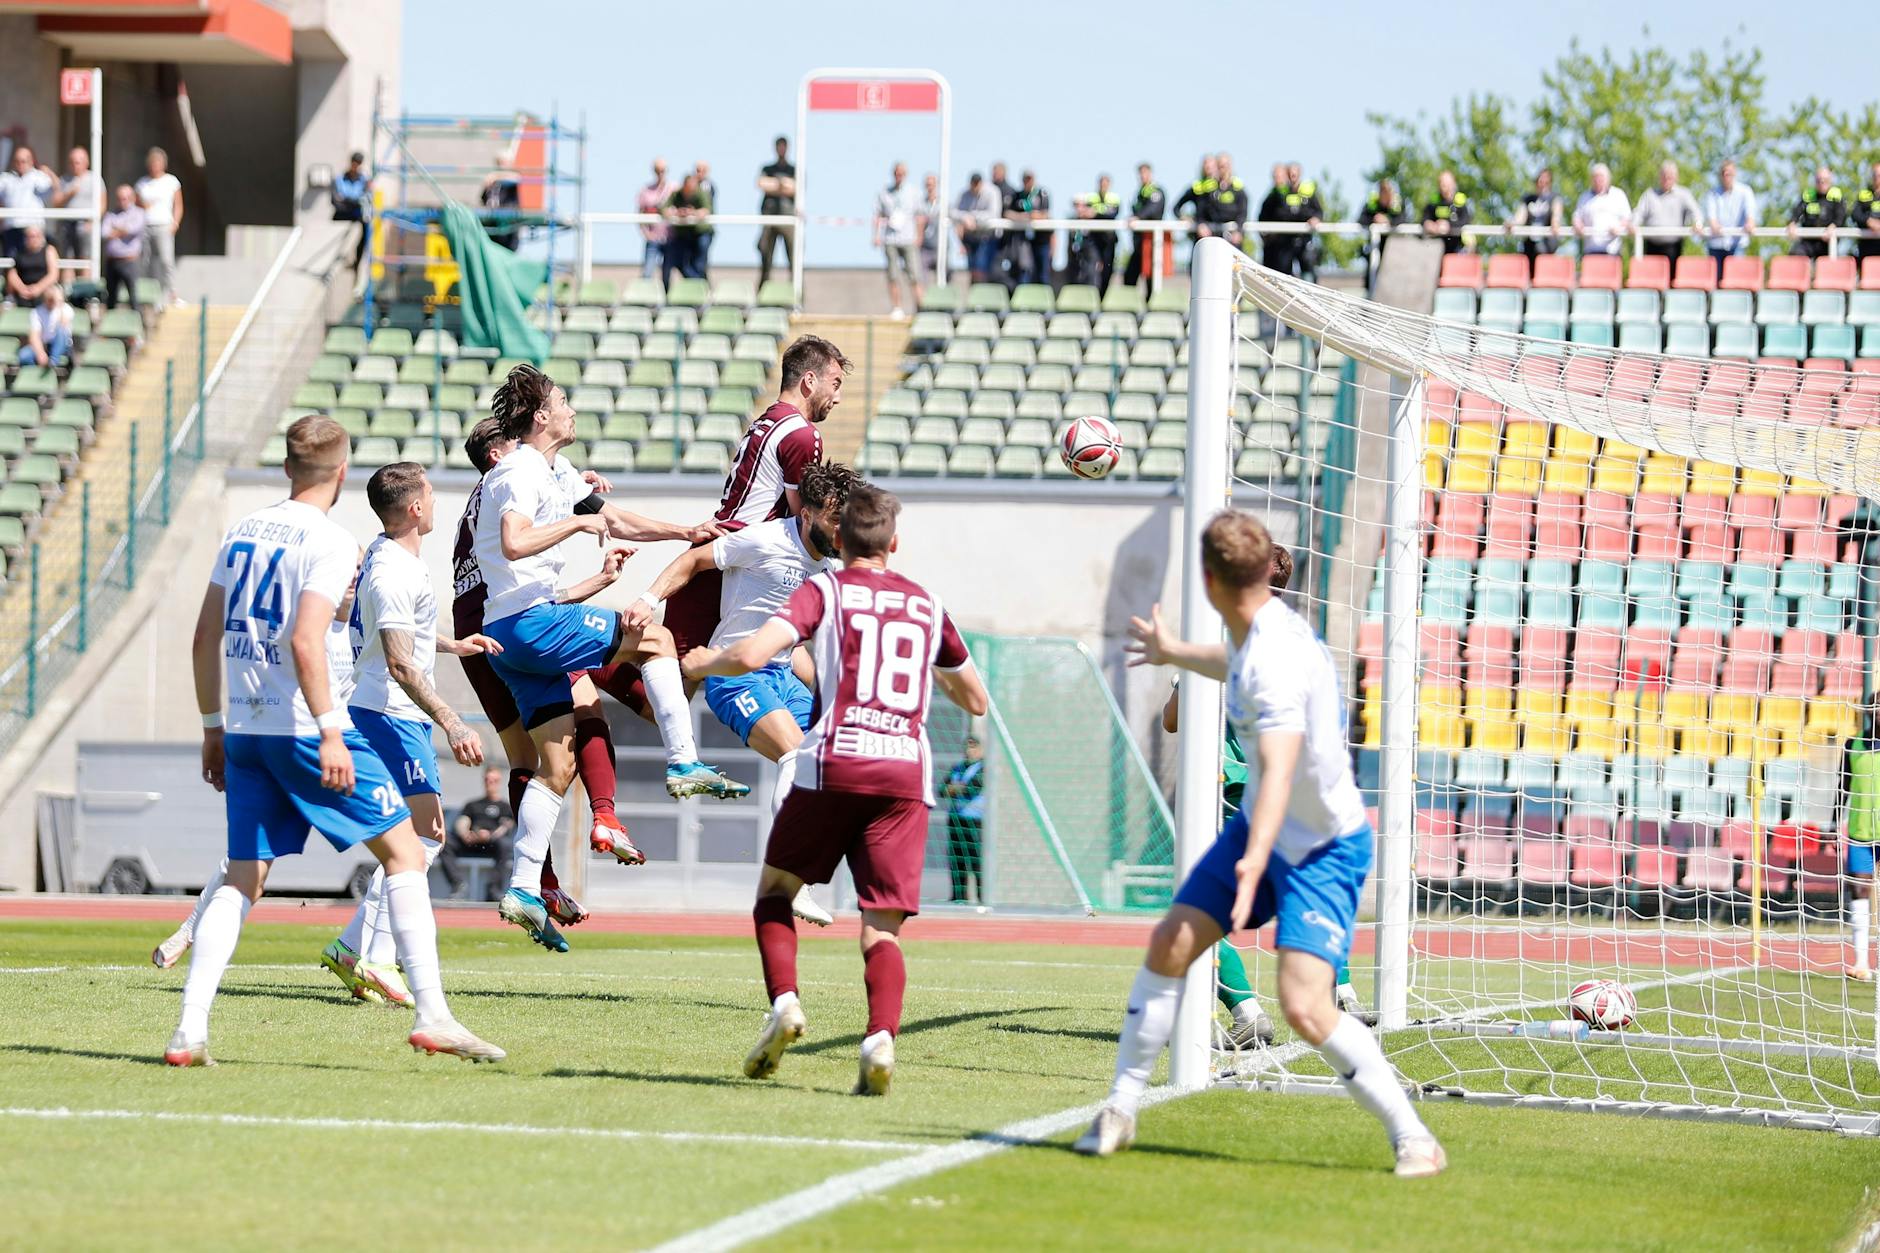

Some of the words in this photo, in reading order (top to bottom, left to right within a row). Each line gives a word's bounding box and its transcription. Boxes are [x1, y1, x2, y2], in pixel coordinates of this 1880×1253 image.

[260, 521, 310, 547] BERLIN
[225, 540, 286, 640] 24
[841, 583, 932, 626] BFC
[584, 613, 607, 632] 5
[850, 612, 926, 713] 18
[734, 689, 760, 719] 15
[843, 705, 913, 735] SIEBECK
[860, 732, 918, 760] BBK
[403, 758, 427, 786] 14
[372, 780, 405, 817] 24
